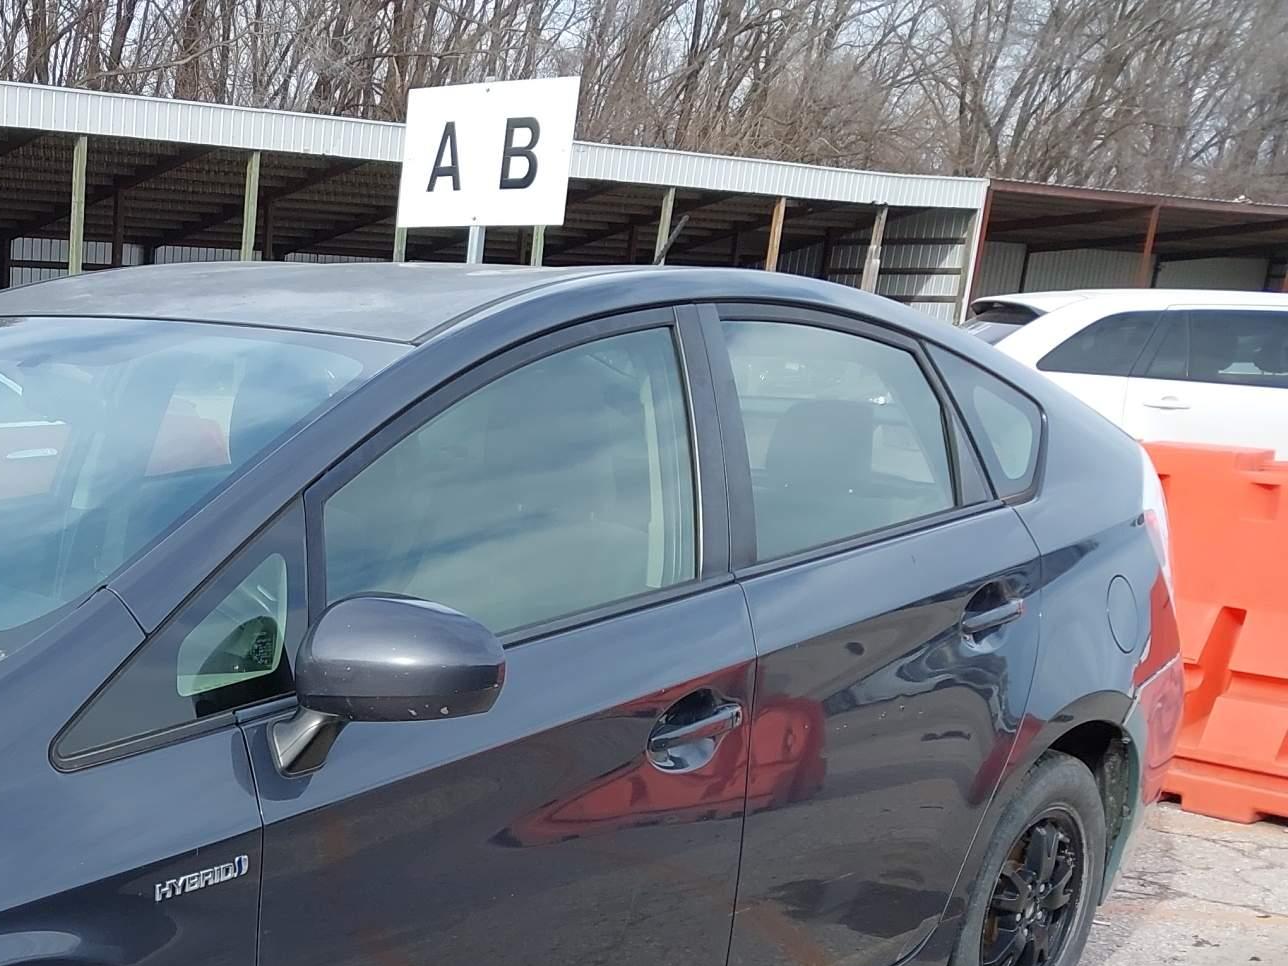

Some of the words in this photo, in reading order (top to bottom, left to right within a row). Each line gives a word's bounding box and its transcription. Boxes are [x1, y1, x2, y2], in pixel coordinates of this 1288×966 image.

[426, 120, 461, 192] A
[499, 116, 541, 190] B
[154, 862, 235, 902] HYBRID
